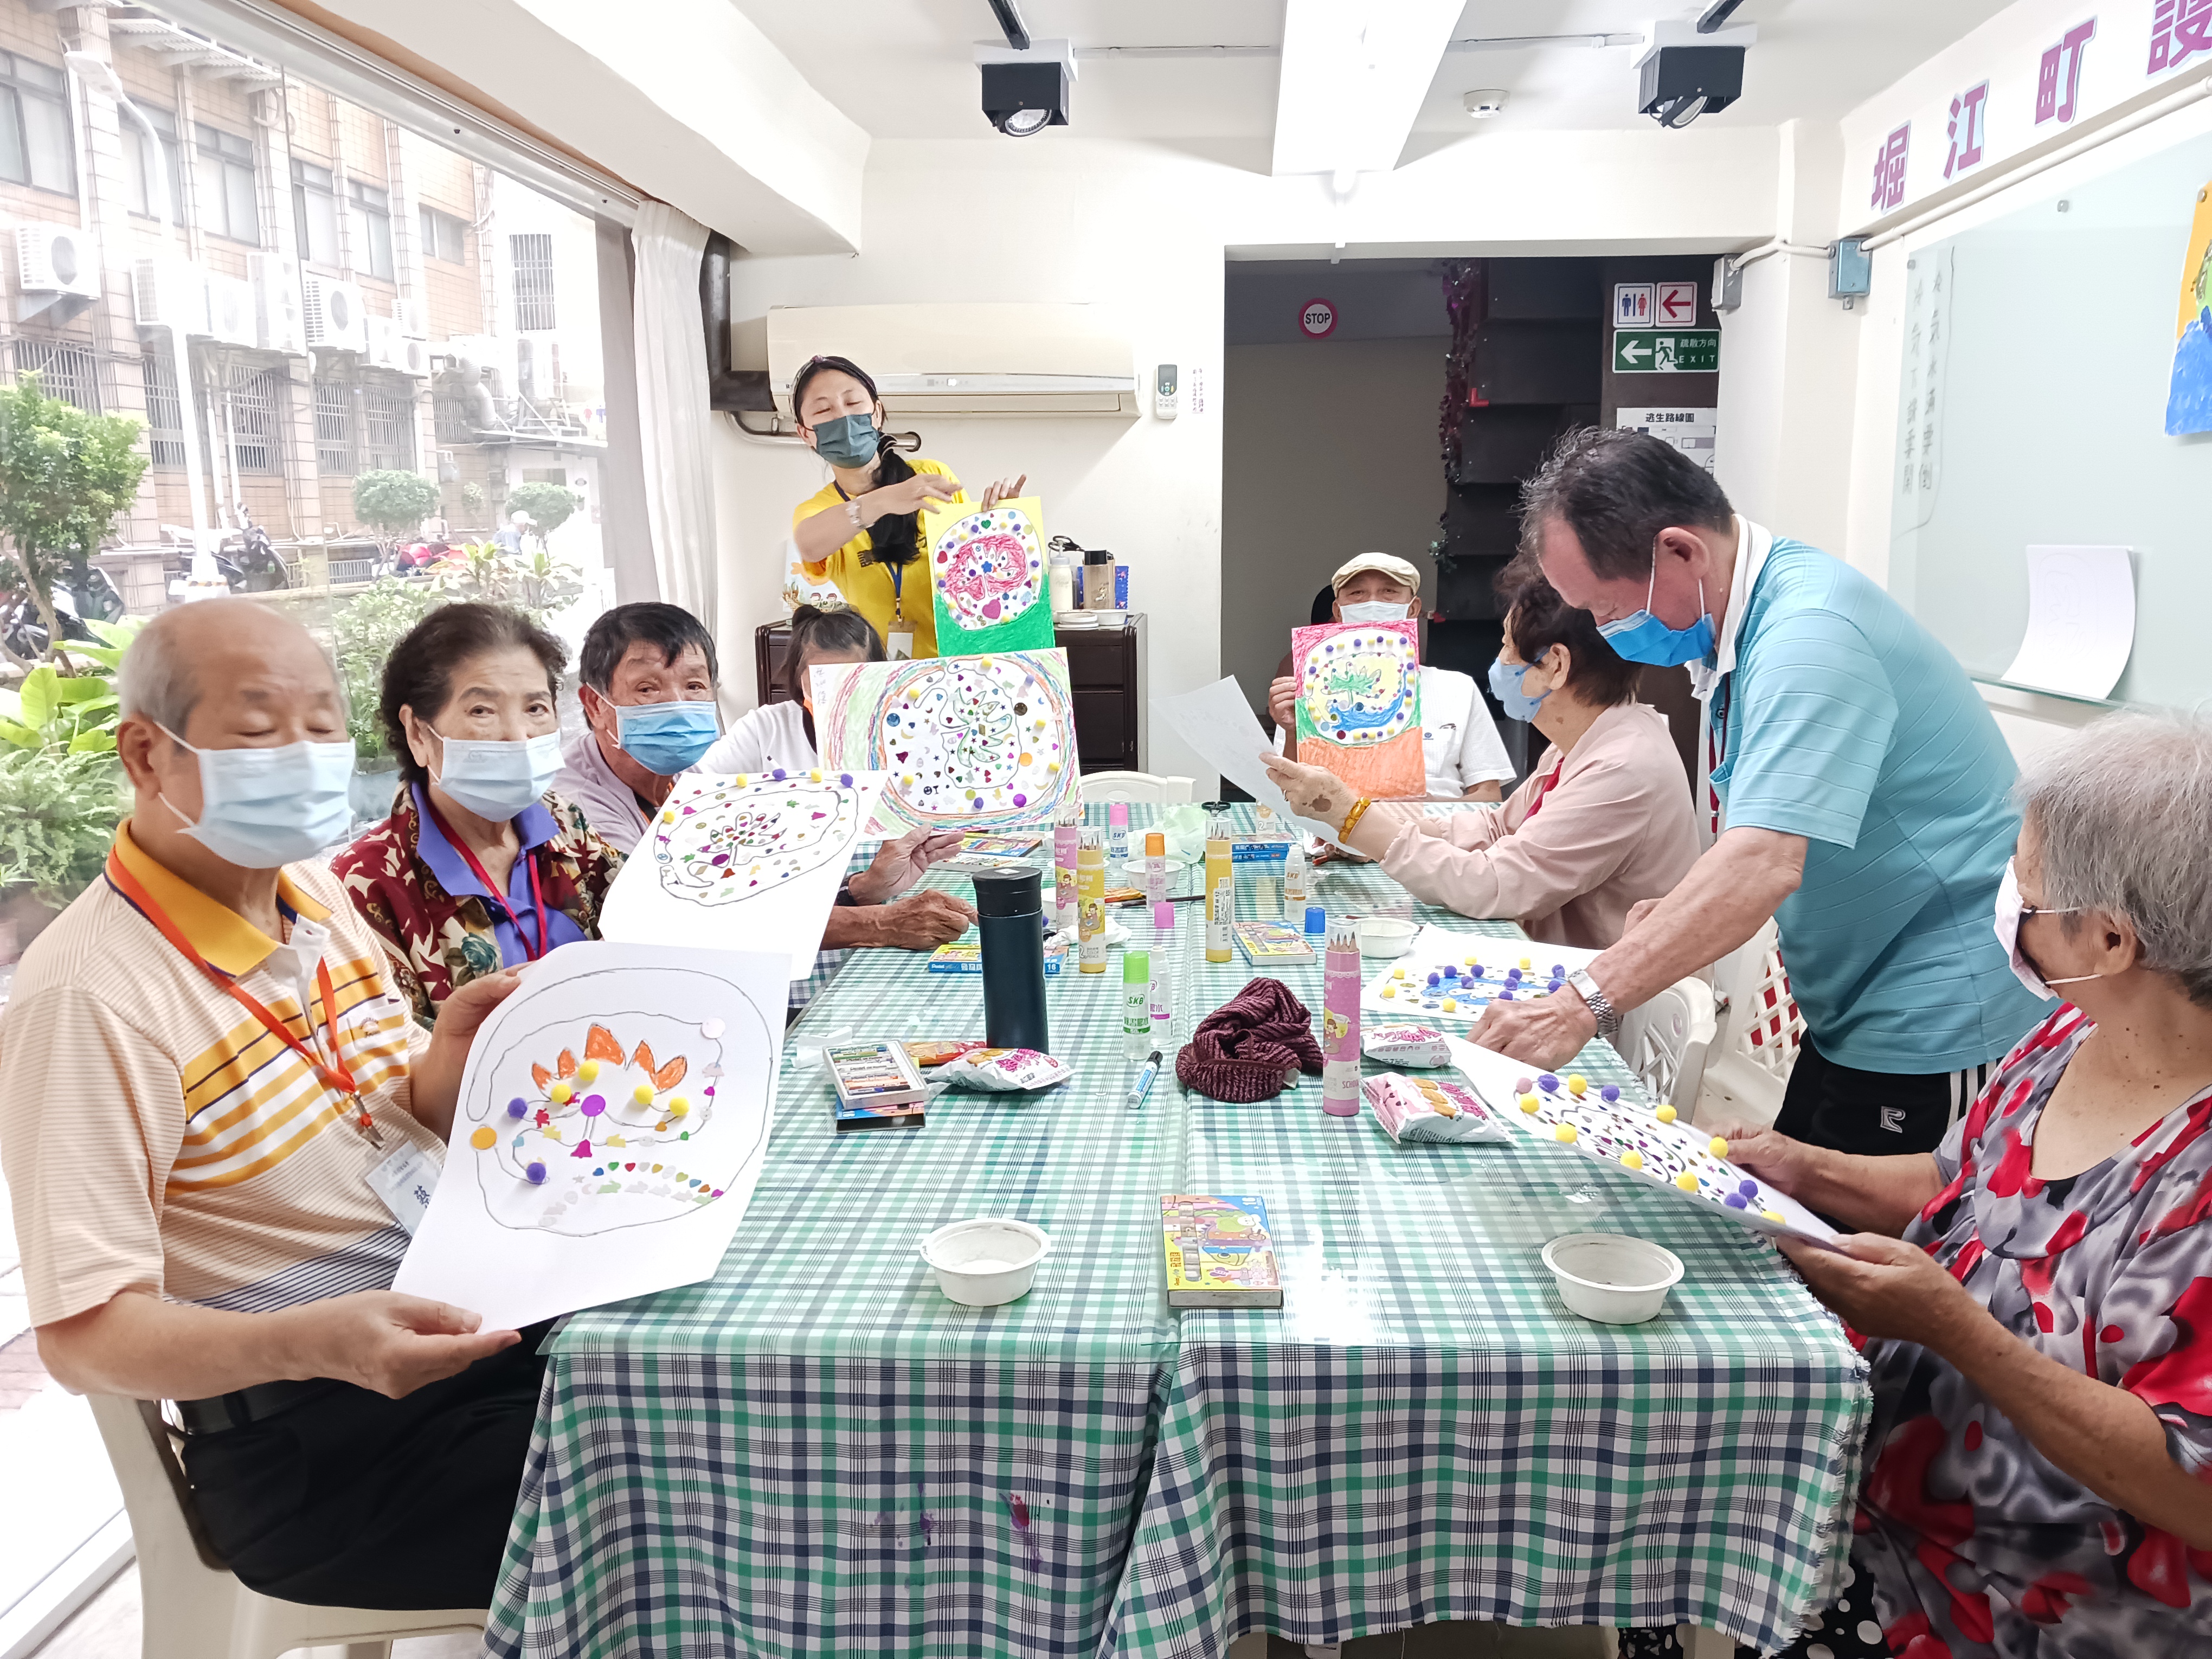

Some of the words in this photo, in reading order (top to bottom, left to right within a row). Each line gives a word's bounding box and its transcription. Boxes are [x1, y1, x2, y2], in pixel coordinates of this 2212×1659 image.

[1306, 313, 1330, 324] STOP
[1680, 338, 1716, 348] 疏散方向
[1679, 355, 1715, 363] EXIT
[1645, 413, 1694, 422] 逃生路線圖
[1128, 996, 1143, 1005] SKB
